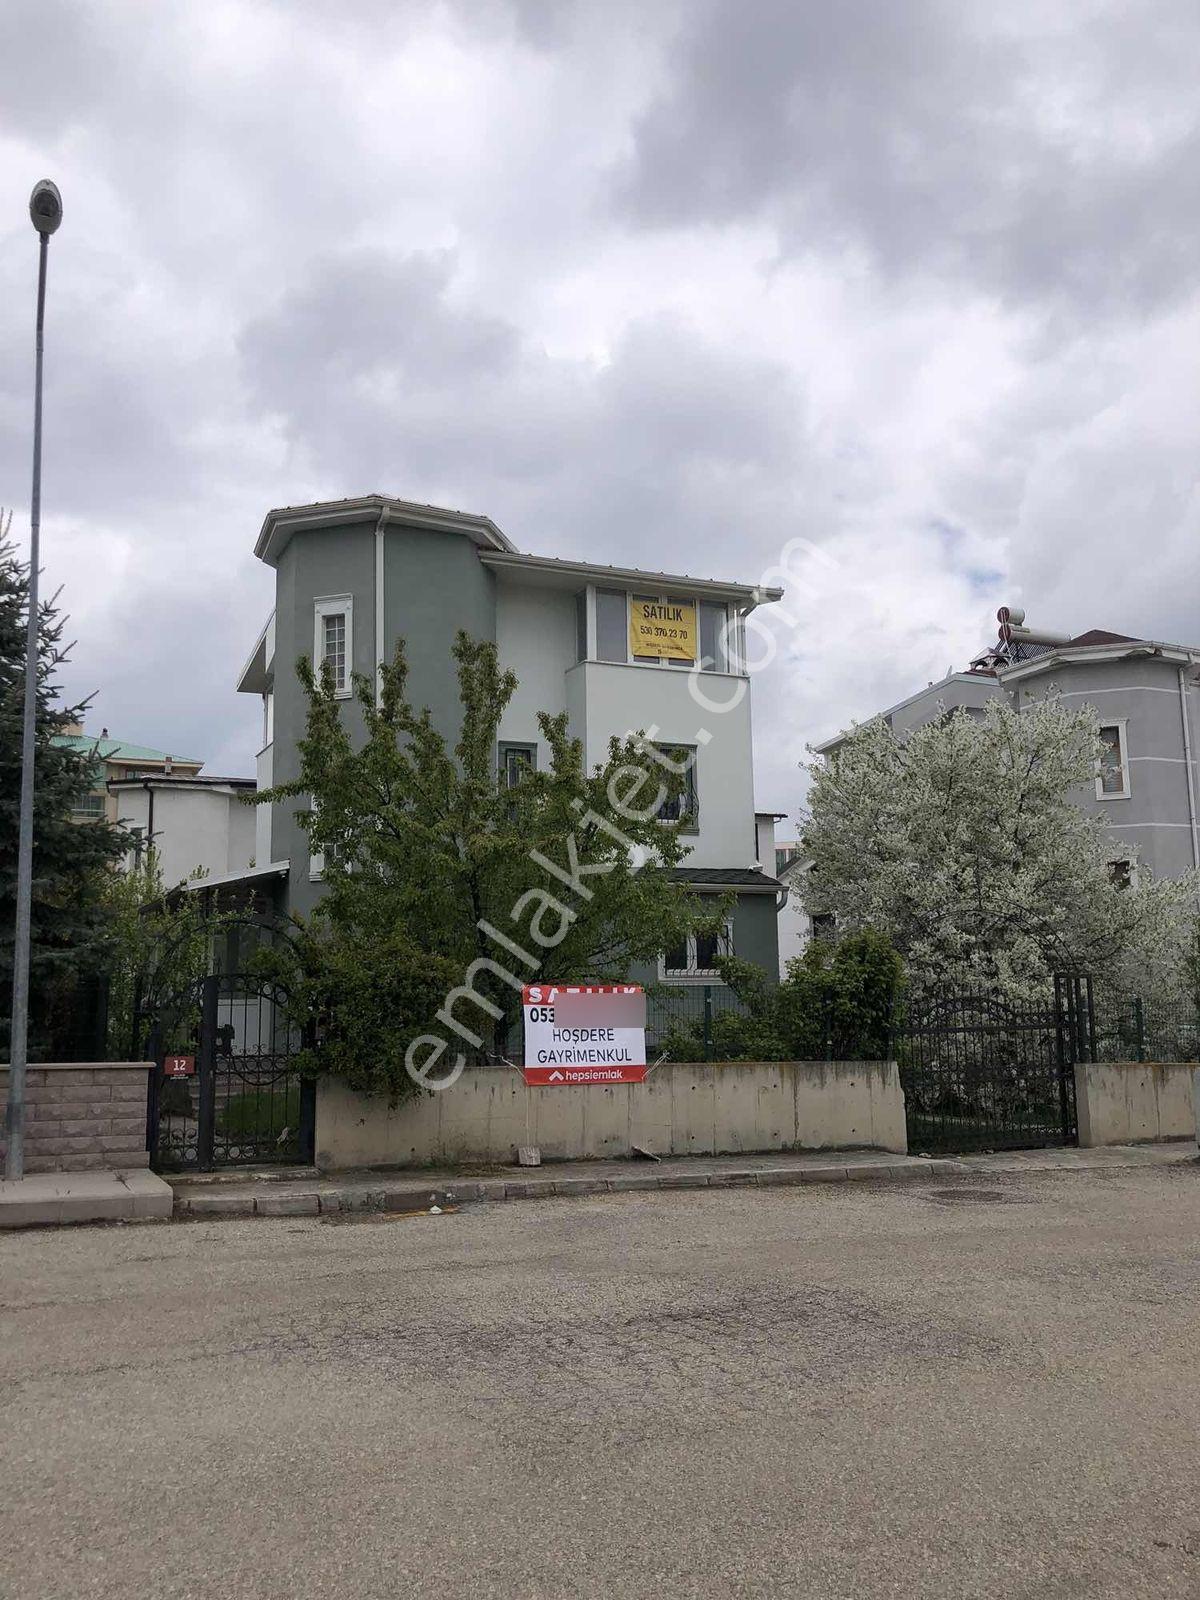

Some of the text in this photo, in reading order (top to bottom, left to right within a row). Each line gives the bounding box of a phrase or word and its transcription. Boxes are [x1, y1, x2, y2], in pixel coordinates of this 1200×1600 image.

[642, 604, 683, 621] SATILIK
[679, 630, 688, 640] 70
[552, 1028, 615, 1044] HOŞDERE
[537, 1046, 632, 1064] GAYRİMENKUL
[173, 1059, 186, 1071] 12
[565, 1069, 623, 1082] hepsiemlak
